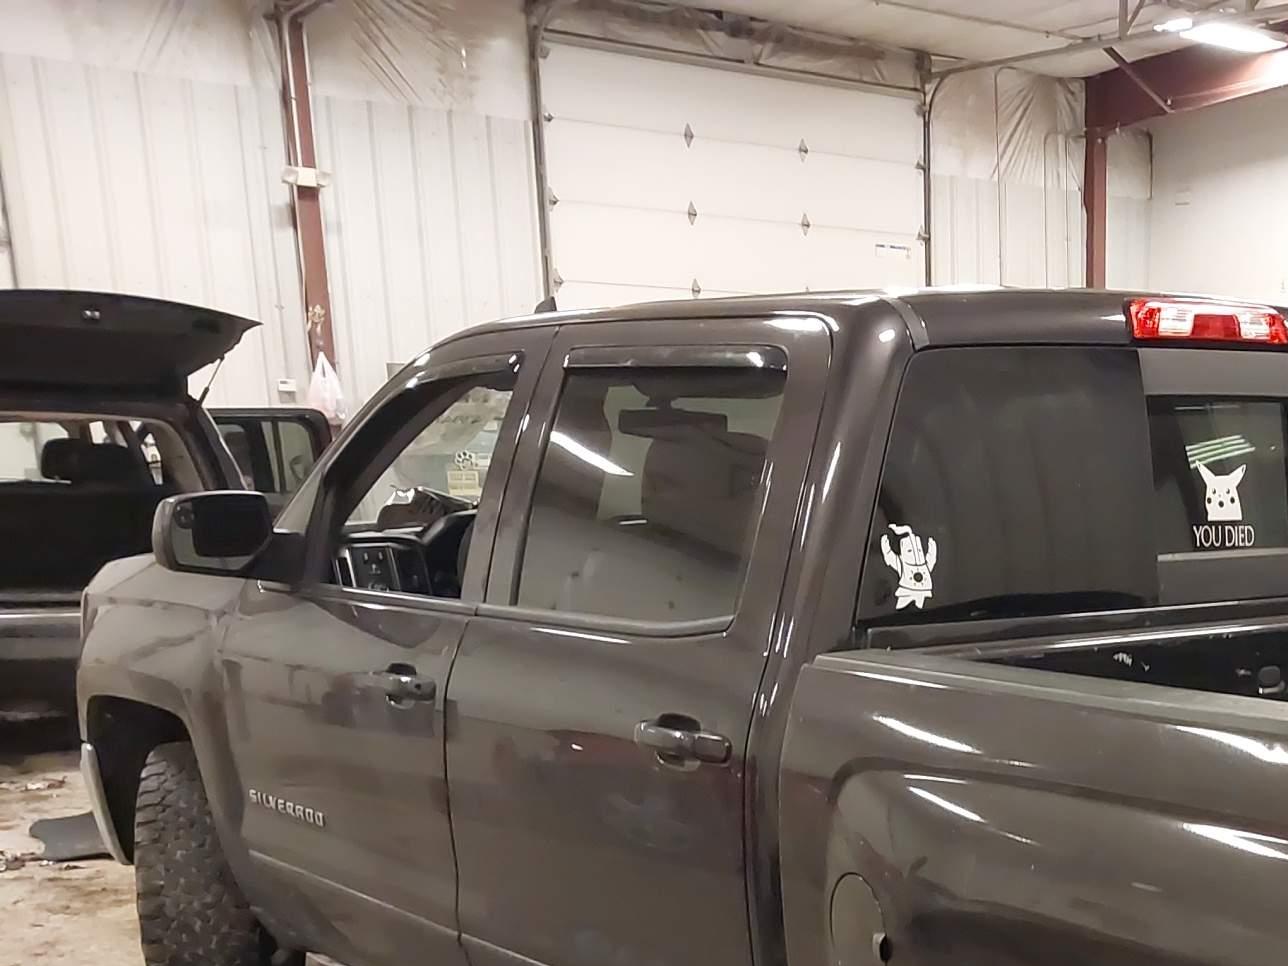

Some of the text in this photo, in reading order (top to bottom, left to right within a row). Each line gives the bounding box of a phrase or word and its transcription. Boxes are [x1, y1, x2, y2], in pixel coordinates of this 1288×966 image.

[1192, 524, 1255, 548] YOU DIED
[248, 788, 324, 827] SILVERADO
